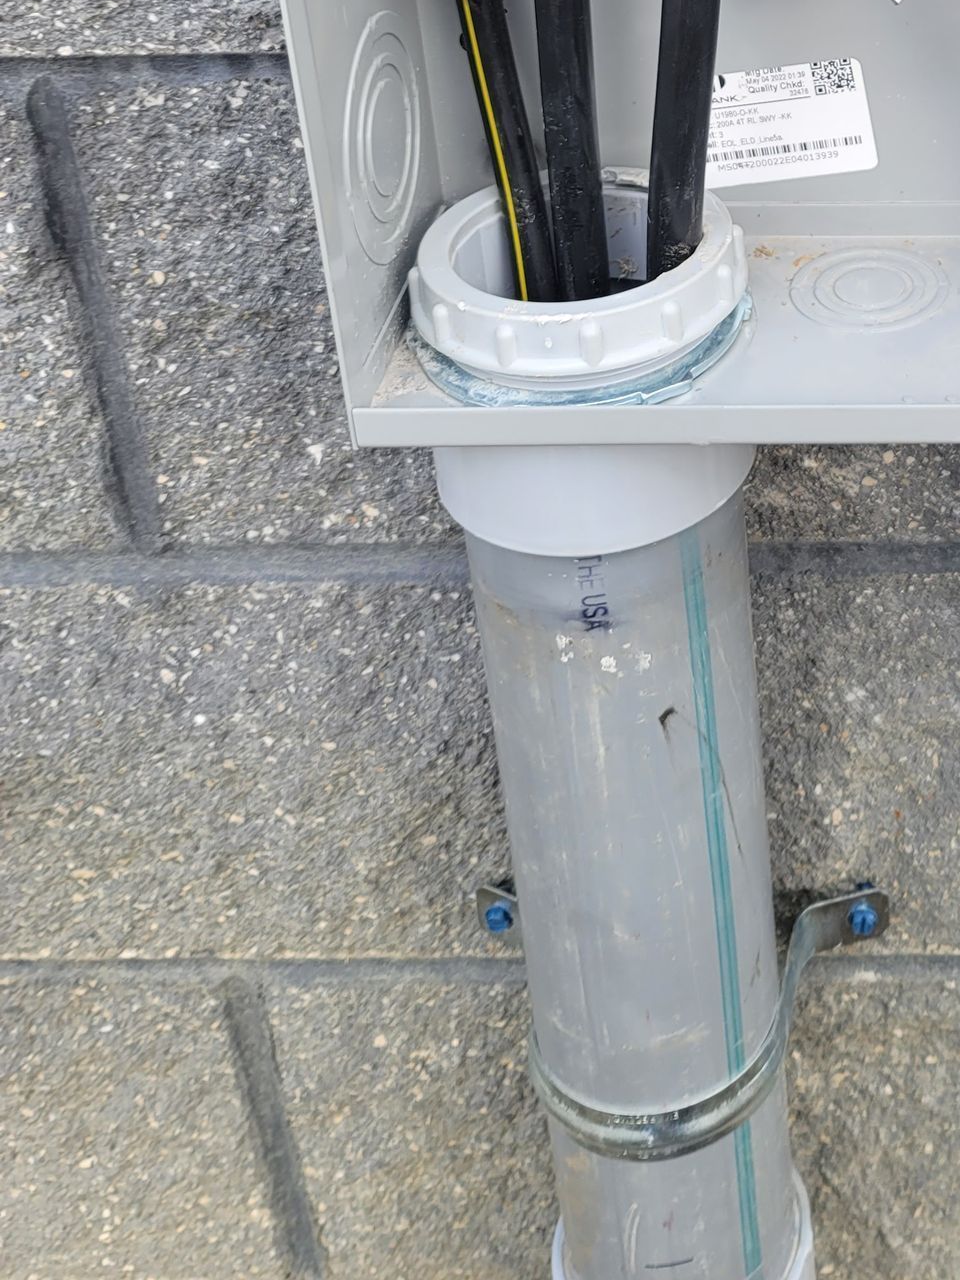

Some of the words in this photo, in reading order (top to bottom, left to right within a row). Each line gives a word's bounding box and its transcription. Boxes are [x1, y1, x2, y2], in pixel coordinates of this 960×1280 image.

[748, 84, 778, 94] Quality
[780, 81, 805, 90] Chkd:
[581, 593, 609, 632] USA
